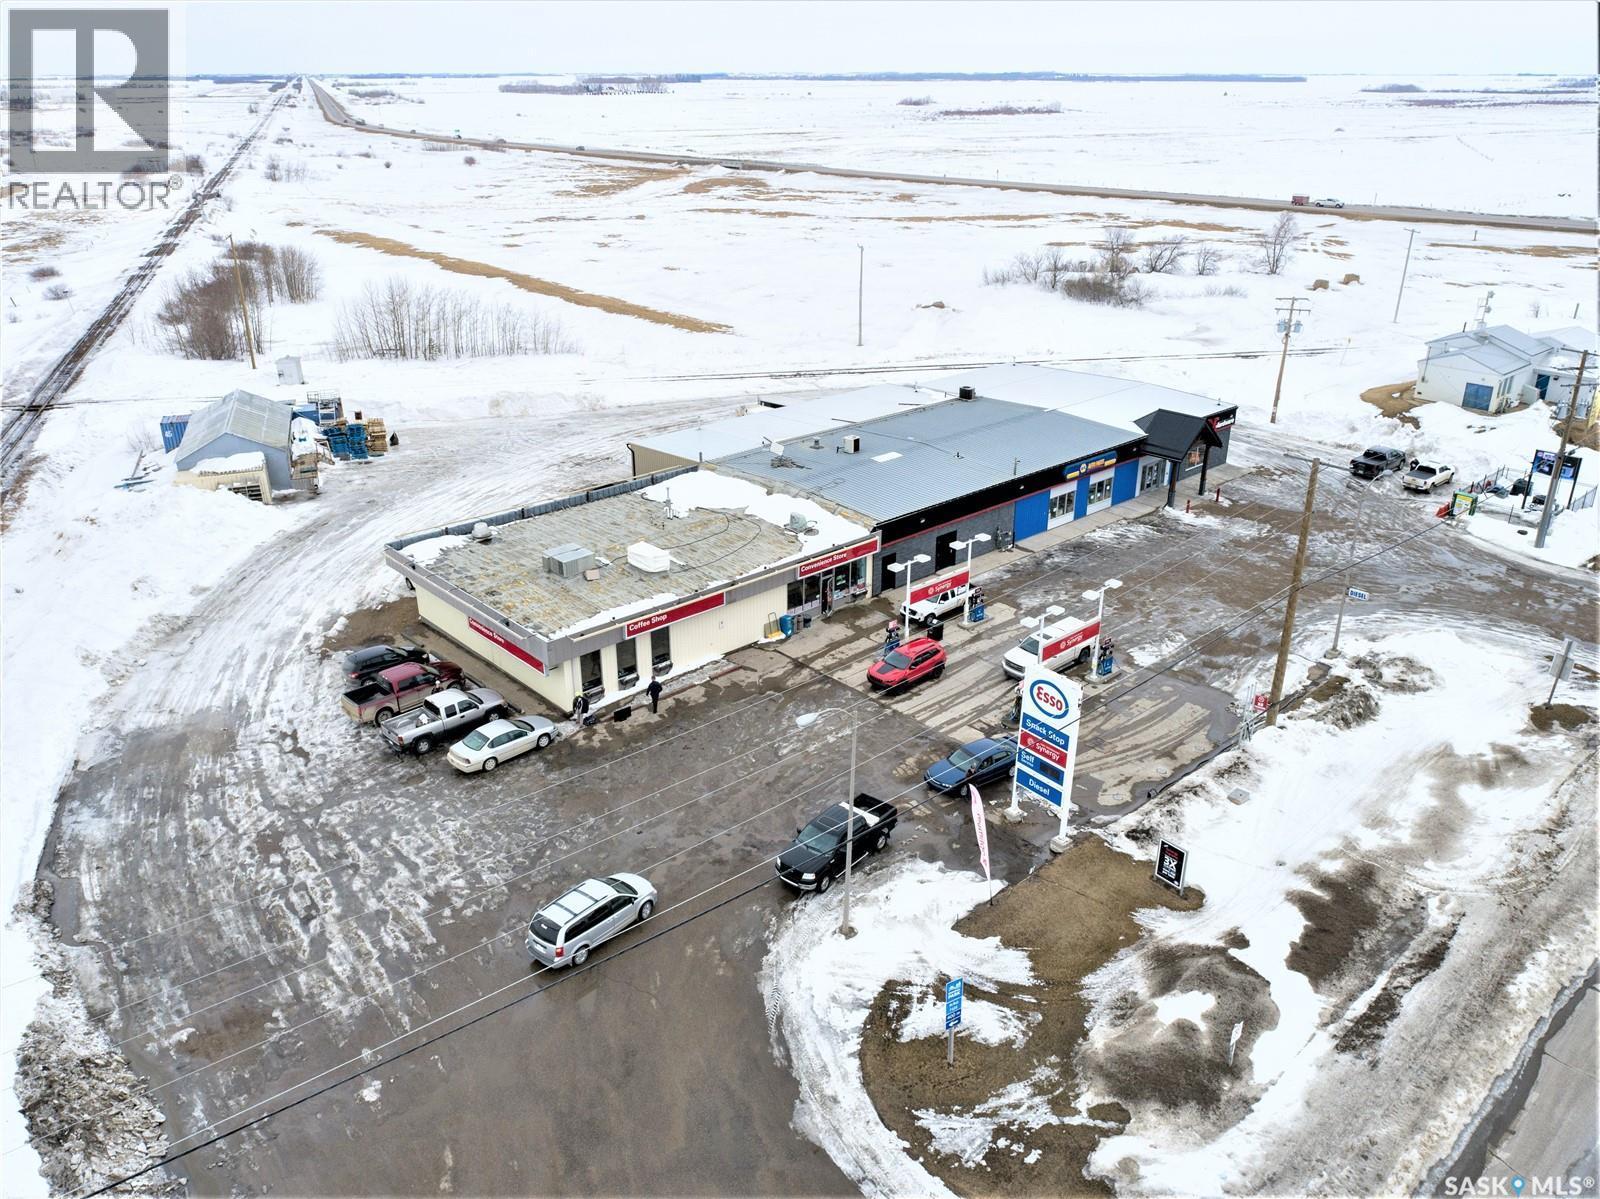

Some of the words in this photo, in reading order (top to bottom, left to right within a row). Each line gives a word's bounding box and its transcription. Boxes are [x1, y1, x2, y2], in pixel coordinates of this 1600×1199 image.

[800, 558, 832, 572] Convenience
[832, 552, 848, 561] Store
[934, 580, 953, 592] Synergy
[1349, 589, 1367, 600] DIESEL
[629, 620, 651, 631] Coffee
[651, 613, 668, 624] Shop
[1066, 633, 1083, 647] Synergy
[1025, 718, 1047, 736] Snack
[1048, 730, 1065, 746] Stop
[1021, 750, 1035, 763] Self
[1035, 742, 1060, 761] Synergy
[1028, 778, 1050, 796] Diesel
